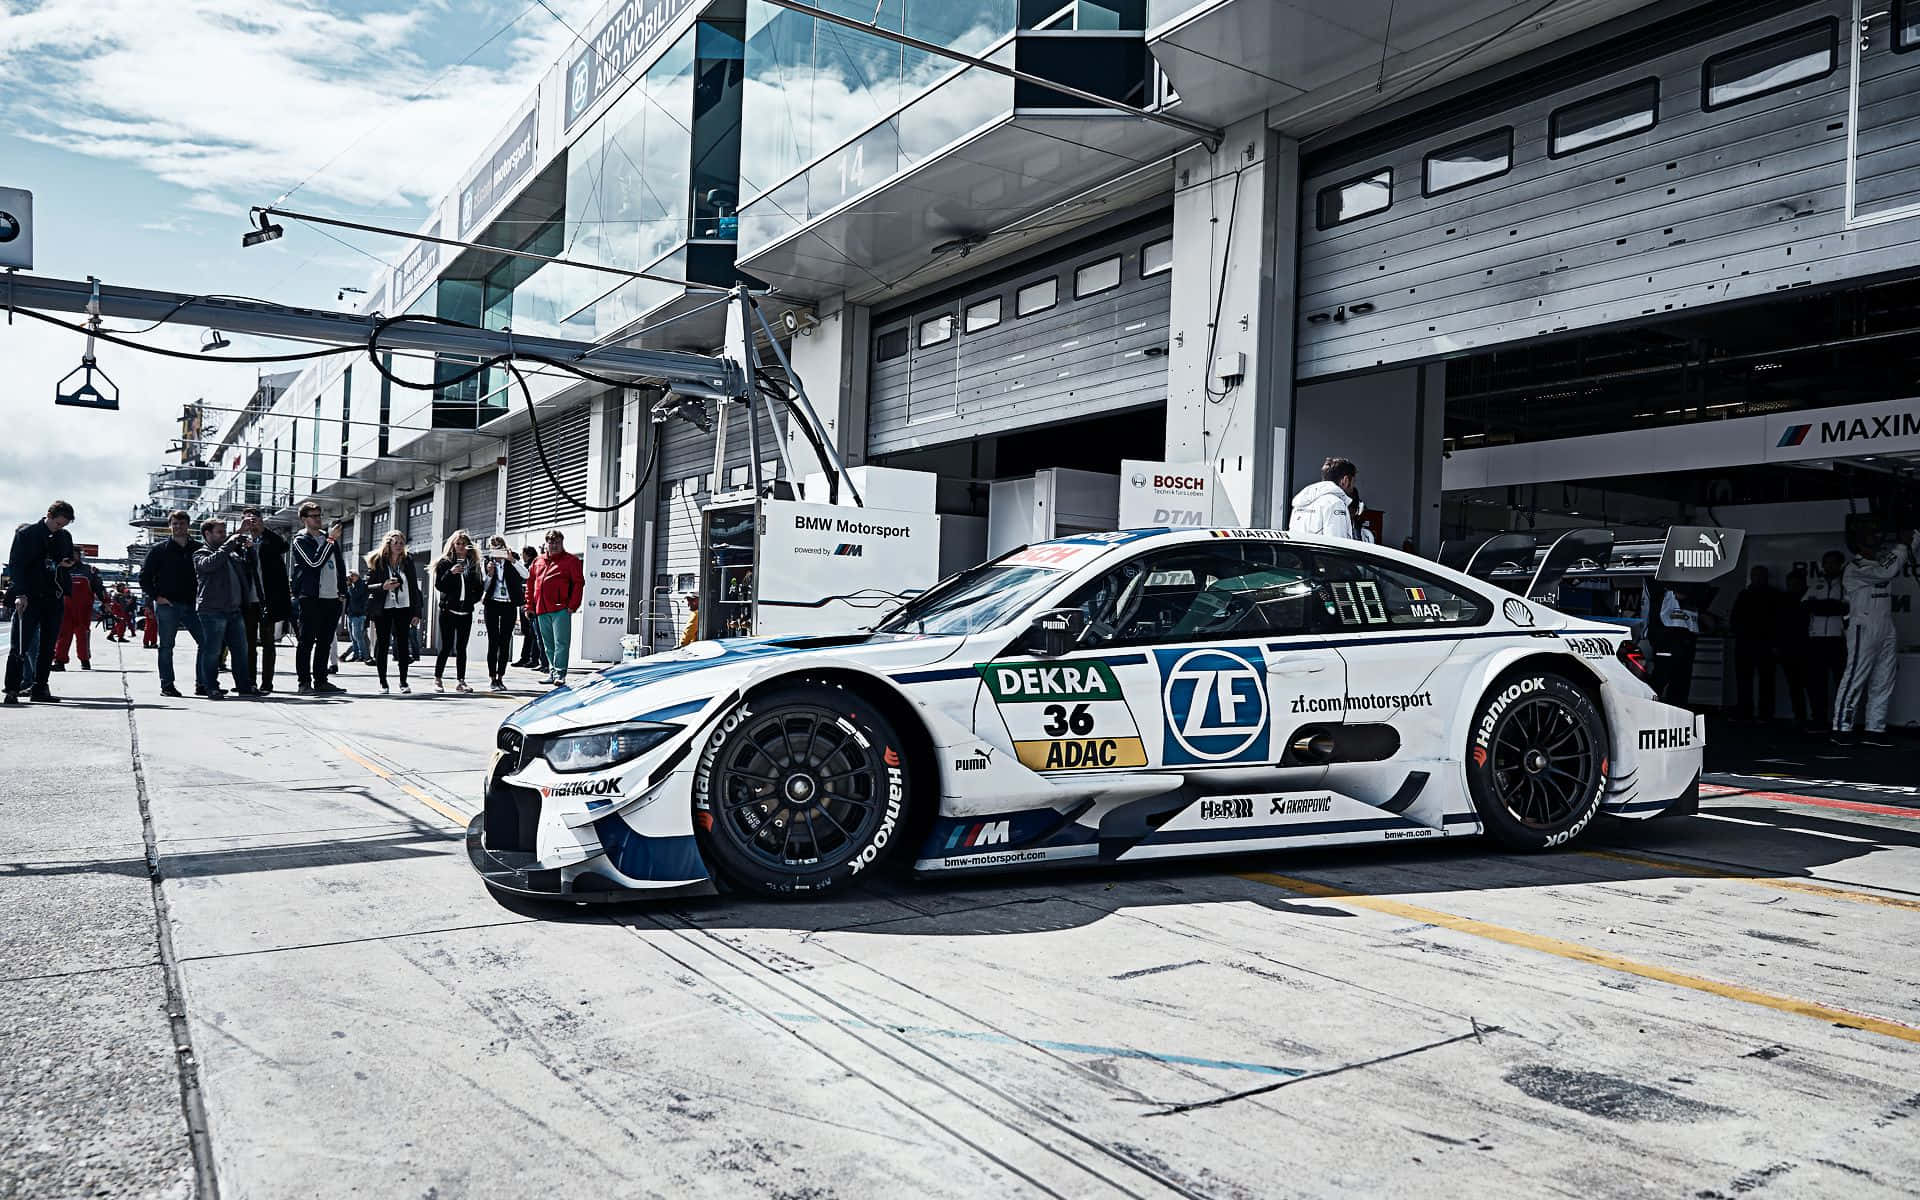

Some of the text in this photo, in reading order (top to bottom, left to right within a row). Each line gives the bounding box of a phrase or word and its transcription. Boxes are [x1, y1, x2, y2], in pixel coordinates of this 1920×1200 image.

[595, 0, 643, 66] MOTION
[594, 0, 686, 97] AND MOBILIT
[493, 131, 532, 188] motorsport
[838, 143, 865, 196] 14
[1153, 475, 1204, 490] BOSCH
[1153, 509, 1202, 526] DTM
[795, 516, 910, 538] BMW Motorsport
[1231, 530, 1290, 540] MARTIN
[794, 546, 822, 555] powered
[823, 547, 831, 556] by
[1675, 549, 1714, 568] PUMA
[602, 559, 626, 567] DTM
[601, 588, 625, 596] DTM
[1410, 604, 1442, 617] MAR
[1042, 620, 1066, 631] PUMA
[997, 667, 1107, 695] DEKRA
[1168, 665, 1263, 741] ZF
[1043, 703, 1095, 738] 36
[1638, 726, 1691, 750] MAHLE
[1045, 739, 1118, 770] ADAC
[955, 758, 987, 771] PUMA
[1384, 830, 1432, 839] bmw-m.com
[944, 850, 1046, 867] bmw-motorsport.com
